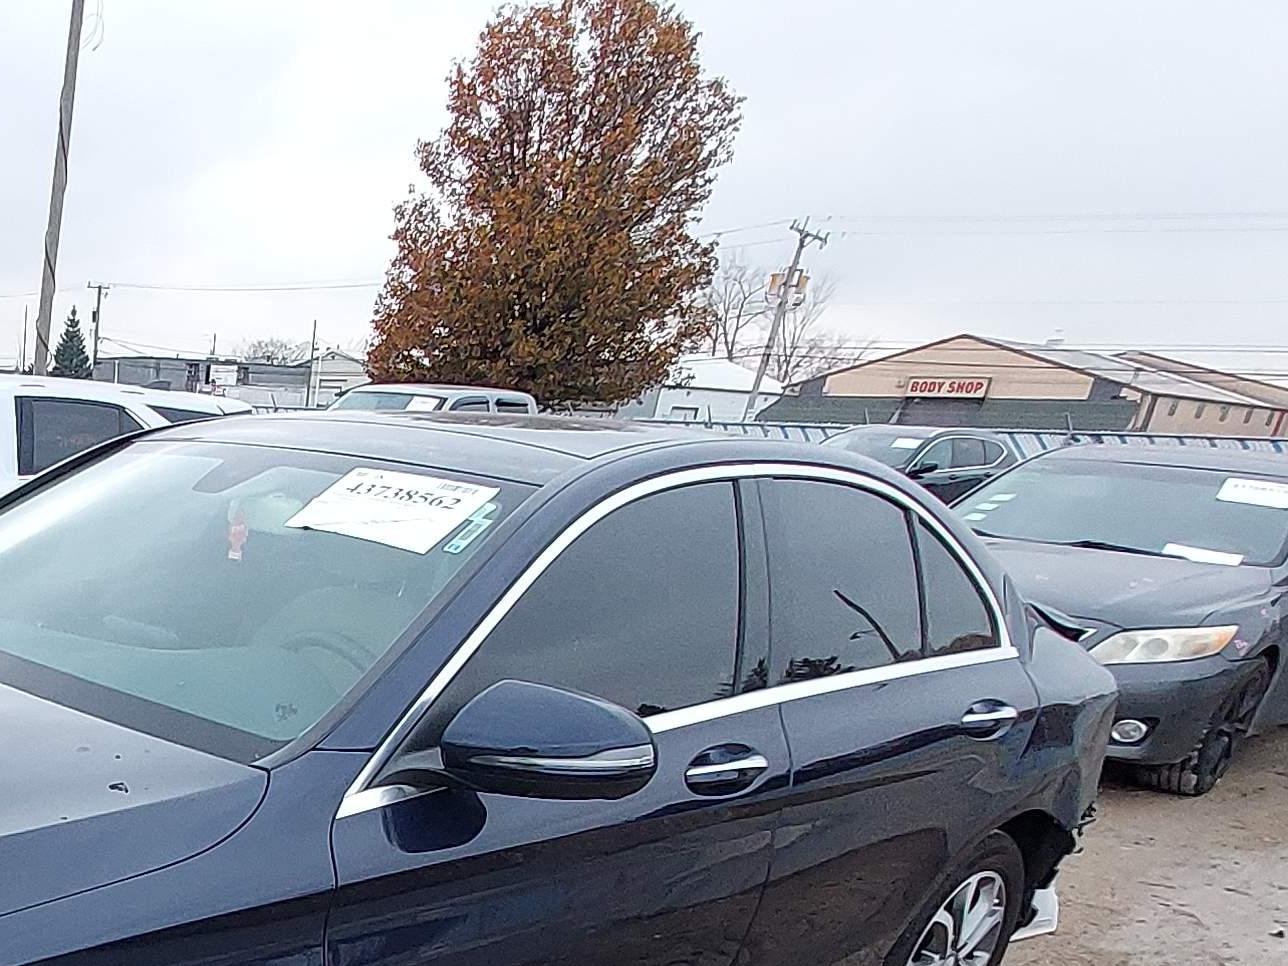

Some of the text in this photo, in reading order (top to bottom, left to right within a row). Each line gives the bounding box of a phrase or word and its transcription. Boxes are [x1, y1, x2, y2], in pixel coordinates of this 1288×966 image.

[910, 381, 984, 394] BODY SHOP
[346, 482, 462, 510] 43738562
